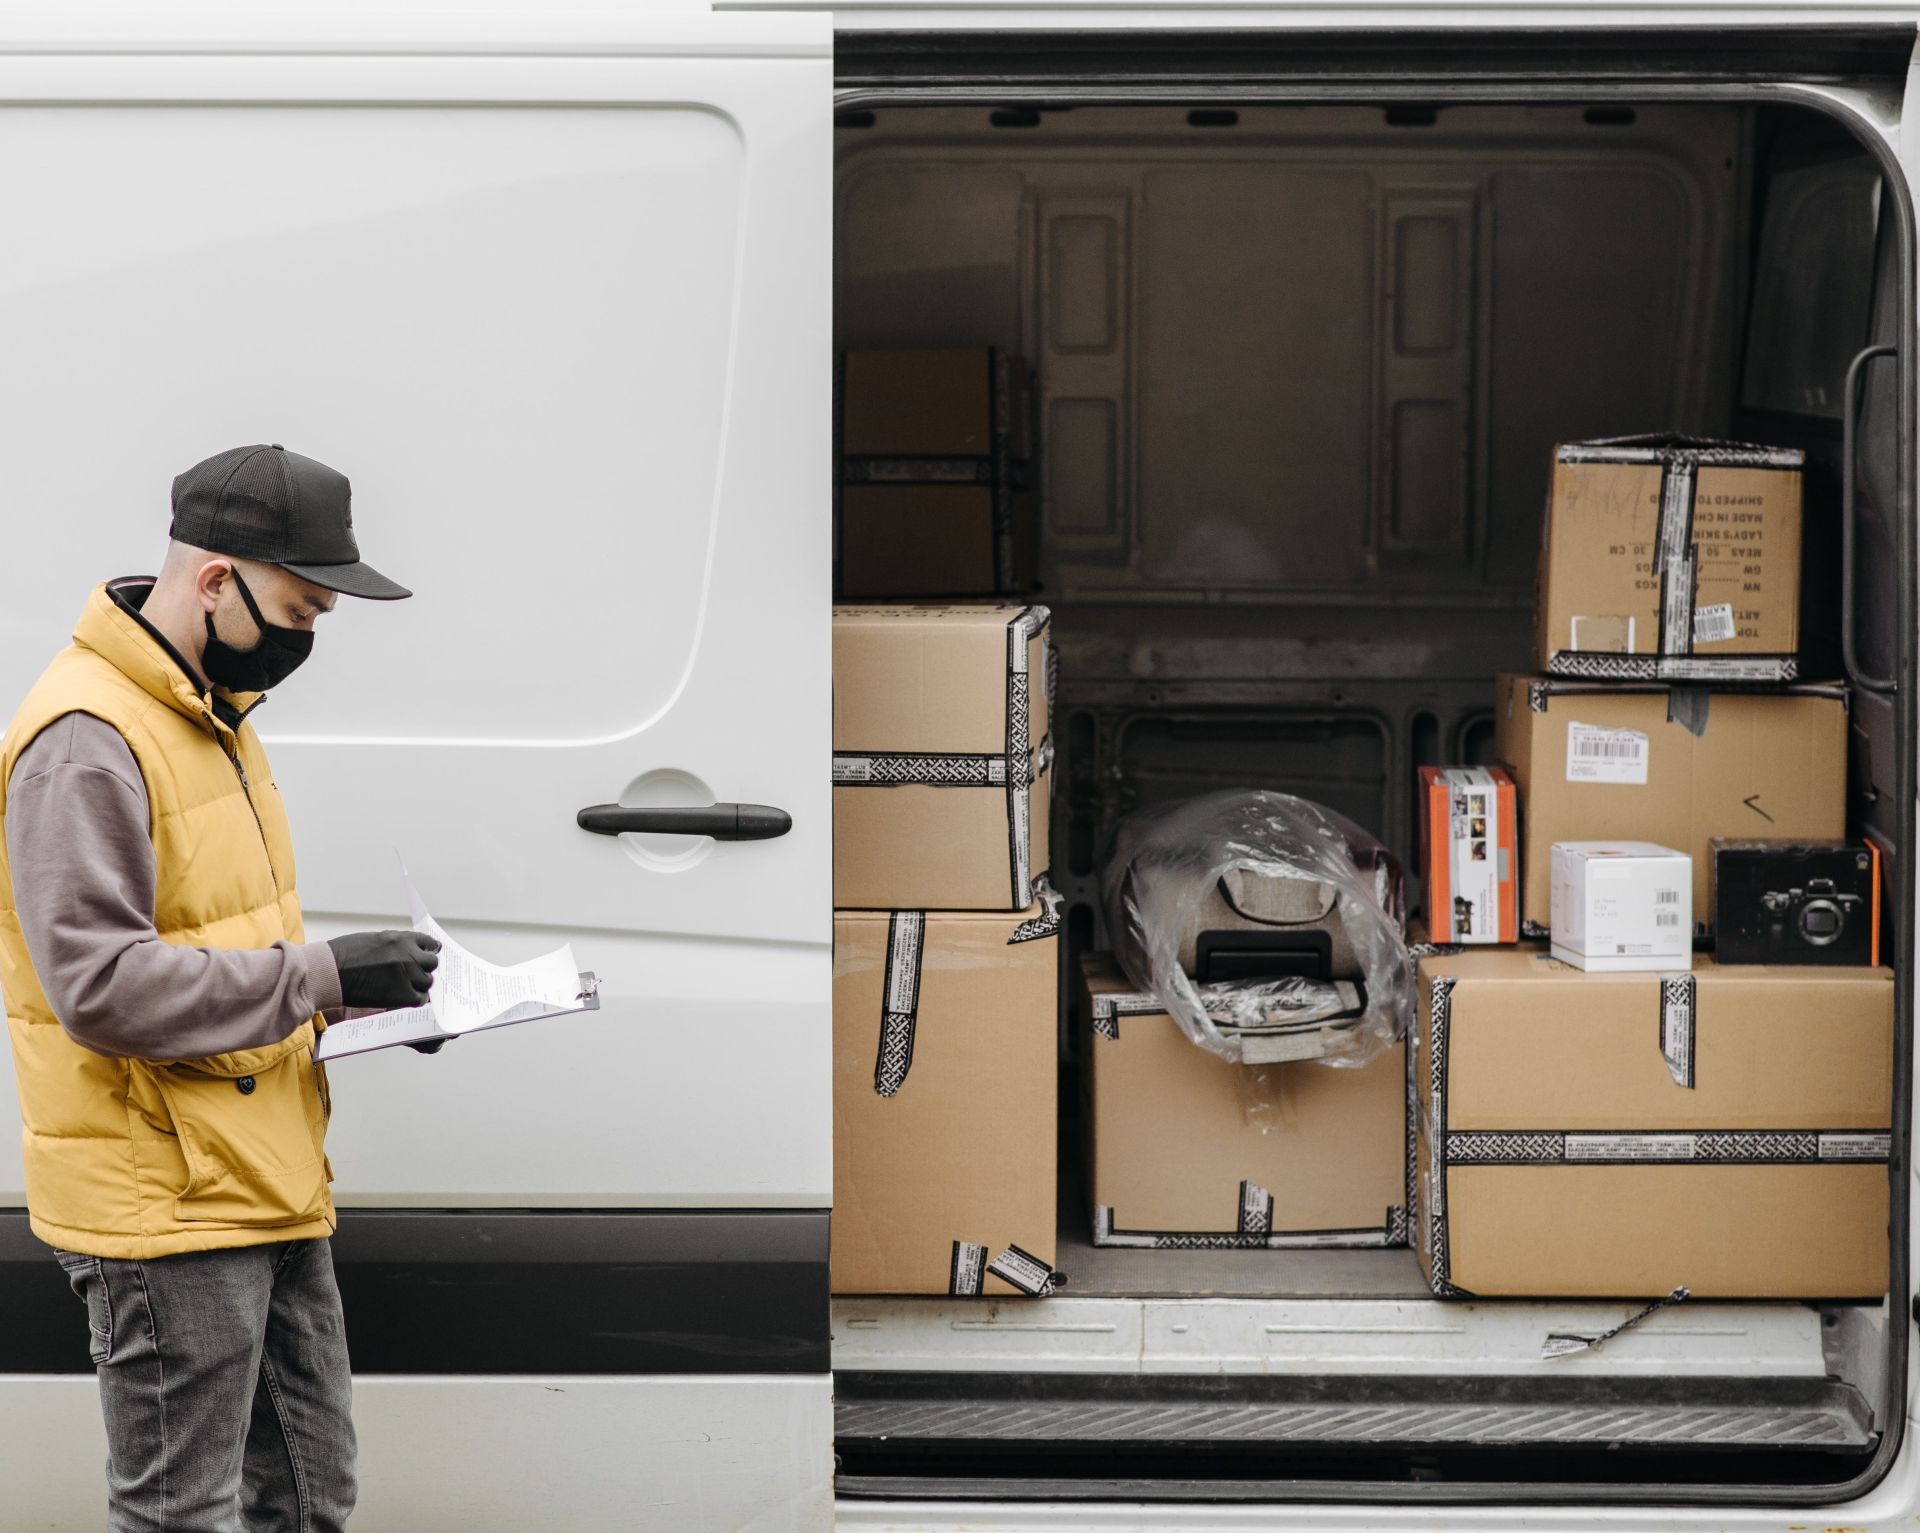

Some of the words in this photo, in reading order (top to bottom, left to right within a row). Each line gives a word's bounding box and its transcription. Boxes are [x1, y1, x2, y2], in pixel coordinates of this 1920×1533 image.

[1697, 495, 1712, 505] TO
[1715, 495, 1763, 506] SHIPPED
[1717, 512, 1729, 523] IN
[1732, 512, 1763, 523] MADE
[1722, 530, 1762, 541] LADY'S
[1609, 545, 1626, 555] CM
[1731, 547, 1762, 558] MEAS
[1635, 563, 1650, 573] GS
[1744, 565, 1761, 575] GW
[1635, 580, 1657, 590] KGS
[1743, 583, 1761, 592] NW
[1737, 627, 1760, 638] TOP
